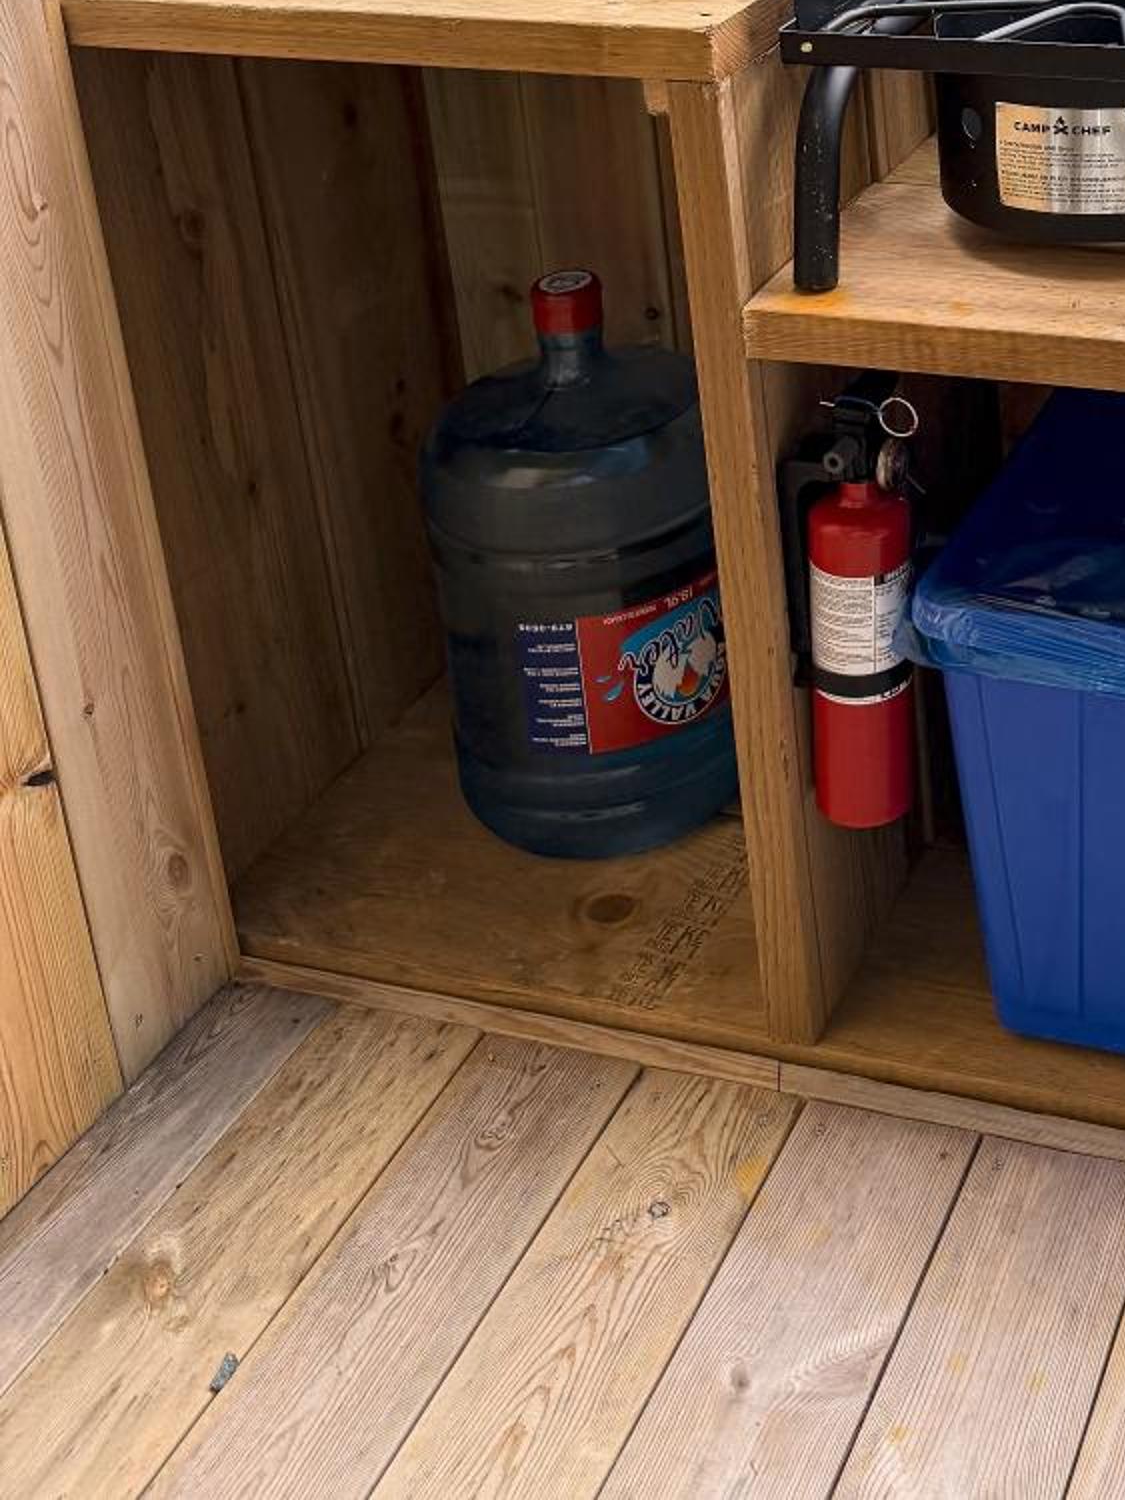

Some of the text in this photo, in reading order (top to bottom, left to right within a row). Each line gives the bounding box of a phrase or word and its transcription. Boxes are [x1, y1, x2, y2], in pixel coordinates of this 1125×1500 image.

[1013, 121, 1112, 136] CAMP CHEF
[636, 682, 698, 721] VALLEY
